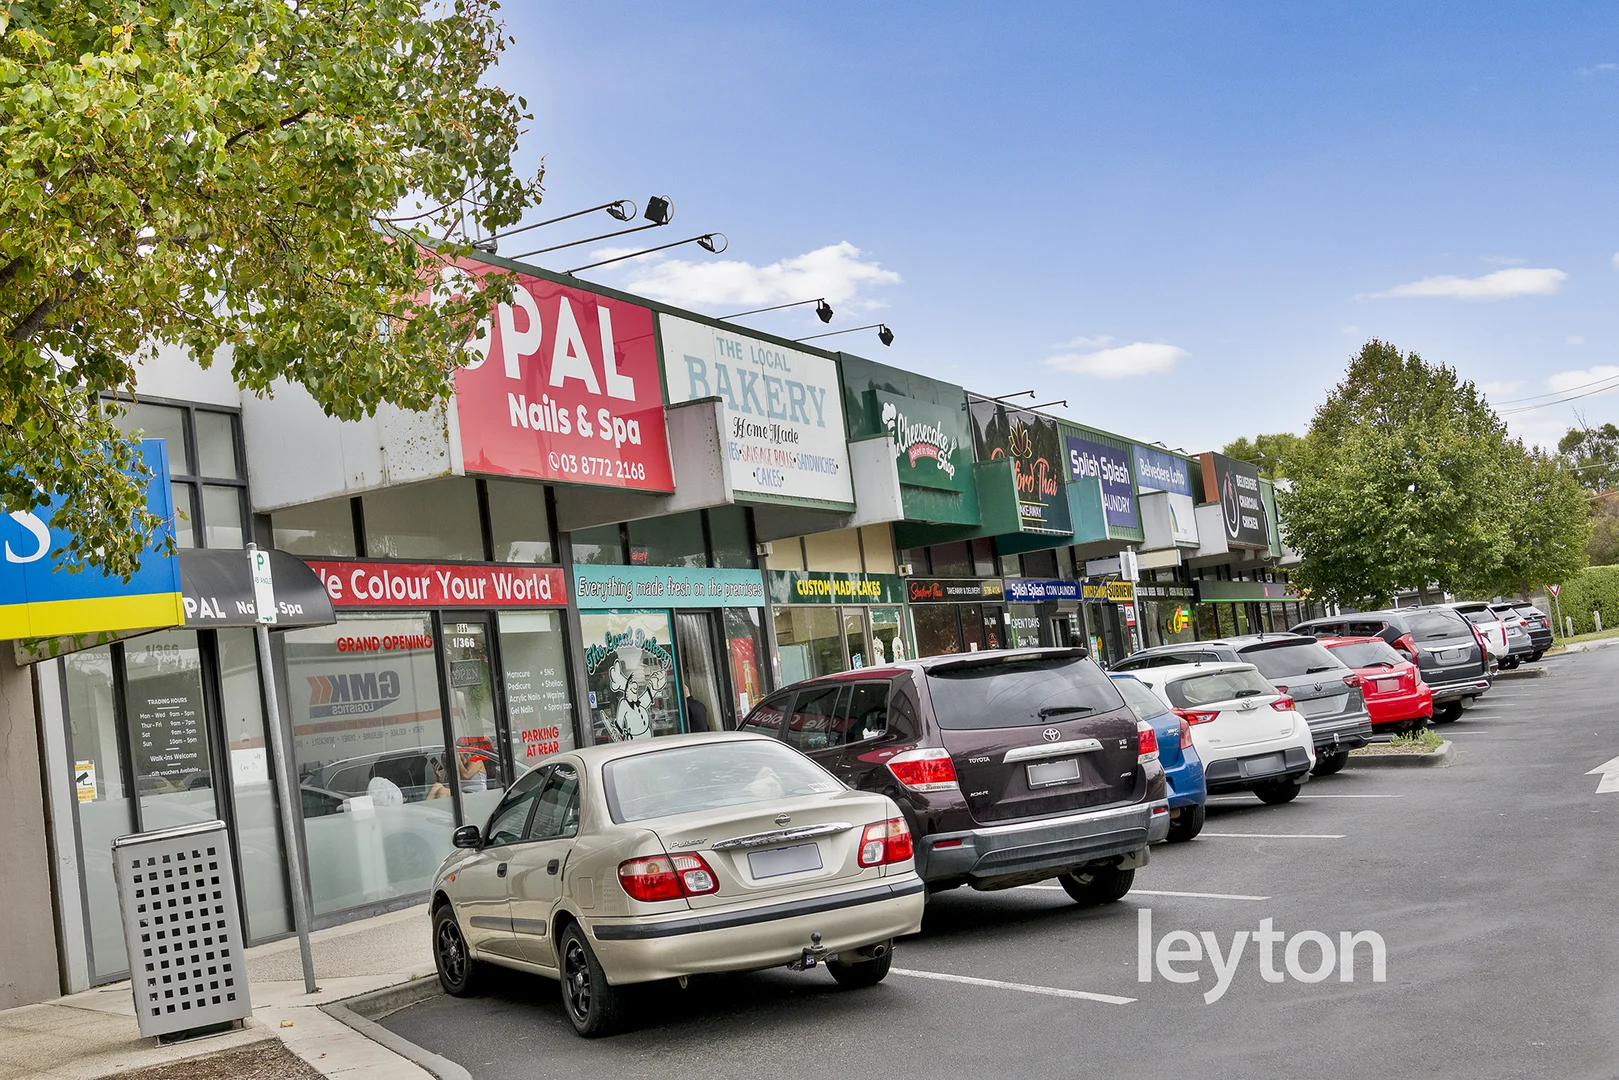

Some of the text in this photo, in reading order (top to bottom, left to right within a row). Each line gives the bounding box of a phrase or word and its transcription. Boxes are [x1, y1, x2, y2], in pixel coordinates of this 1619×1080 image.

[716, 337, 791, 373] THE LOCAL
[683, 354, 826, 428] BAKERY
[508, 393, 640, 448] Nails & Spa
[733, 417, 800, 444] Home Made
[897, 412, 949, 453] Cheesecake
[561, 452, 646, 481] 03 8772 2168
[728, 441, 837, 475] IES SAUSAGE ROLLS SANDWICHES
[937, 450, 955, 481] Shop
[1071, 449, 1130, 486] Splish Splash
[1140, 458, 1184, 486] Belvedere Lotto
[756, 467, 783, 488] CAKES
[1033, 457, 1058, 501] Thai
[1104, 493, 1130, 514] AUNDRY
[256, 553, 264, 572] P
[351, 568, 430, 600] Colour
[436, 571, 487, 600] Your
[492, 573, 552, 600] World
[578, 576, 762, 602] Everything made fresh on the premises
[796, 579, 881, 596] CUSTOM MADE CAKES
[1011, 584, 1028, 598] Splish
[1028, 584, 1045, 598] Splash
[1046, 585, 1057, 596] COIN
[1058, 586, 1076, 596] LAUNDRY
[1108, 584, 1134, 598] SUBNEW
[182, 597, 226, 618] PAL
[279, 601, 304, 617] Spa
[1012, 618, 1025, 628] OPEN
[1028, 618, 1040, 628] DAYS
[145, 644, 179, 657] 1/366
[337, 634, 433, 652] GRAND OPENING
[452, 638, 475, 648] 1/366
[586, 626, 672, 676] The Local Bakery
[506, 670, 530, 678] Manicure
[544, 668, 554, 676] SNS
[508, 682, 531, 690] Pedicure
[545, 680, 564, 688] Shellac
[510, 692, 541, 704] Acrylic Nails
[546, 691, 565, 700] Waxing
[510, 705, 534, 714] Gel Nails
[548, 703, 563, 712] Spray
[522, 726, 560, 743] PARKING
[174, 752, 198, 760] Welcome
[526, 741, 560, 757] AT REAR
[669, 836, 708, 849] Pulsar
